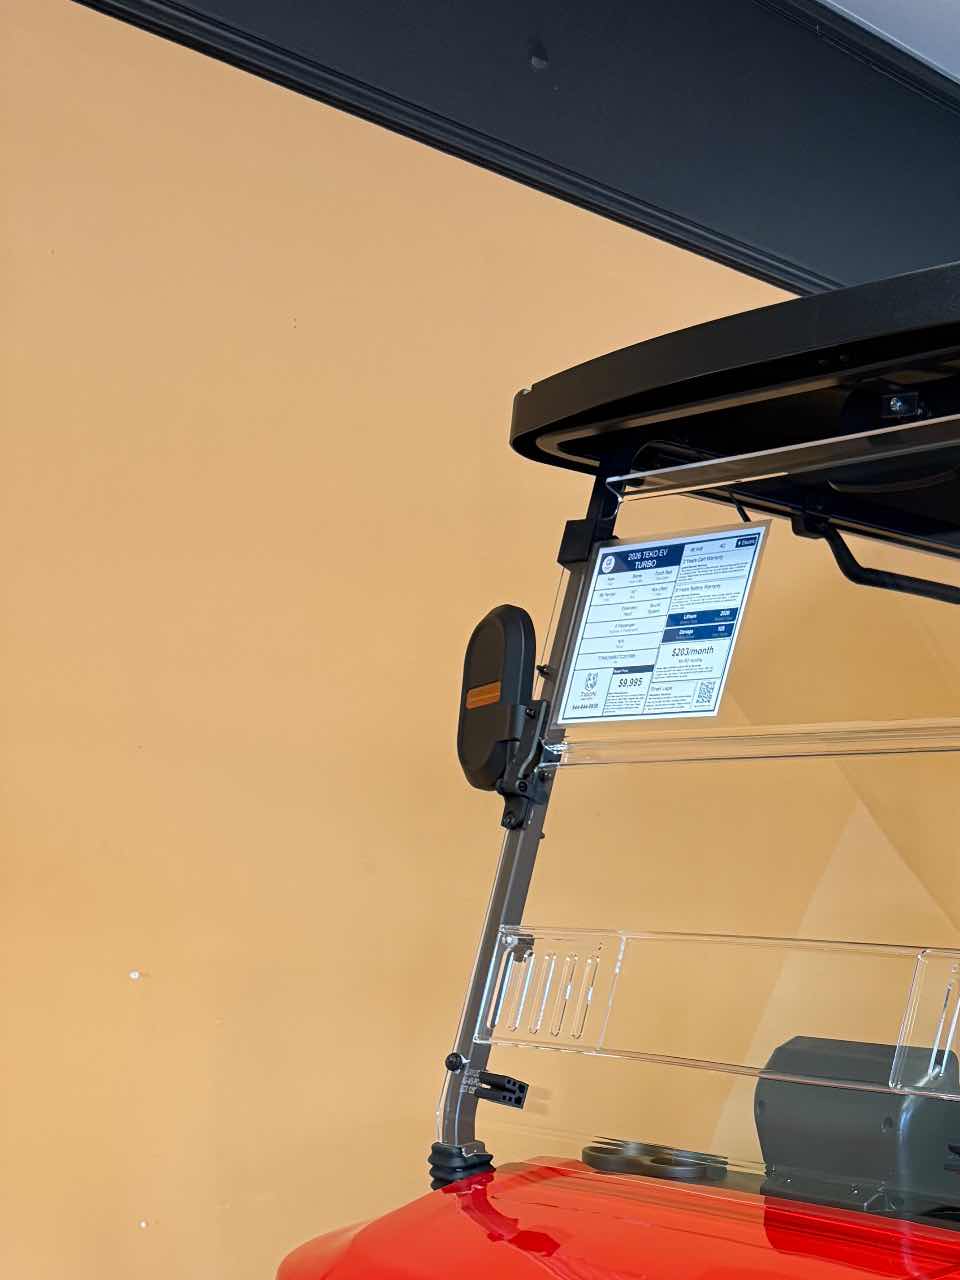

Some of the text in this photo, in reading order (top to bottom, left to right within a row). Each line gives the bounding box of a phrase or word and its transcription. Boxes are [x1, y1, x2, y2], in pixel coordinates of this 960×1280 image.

[627, 548, 668, 561] 2026 TEKO EV
[635, 559, 657, 569] TURBO
[672, 645, 714, 657] $203/month
[618, 677, 644, 688] $9,995
